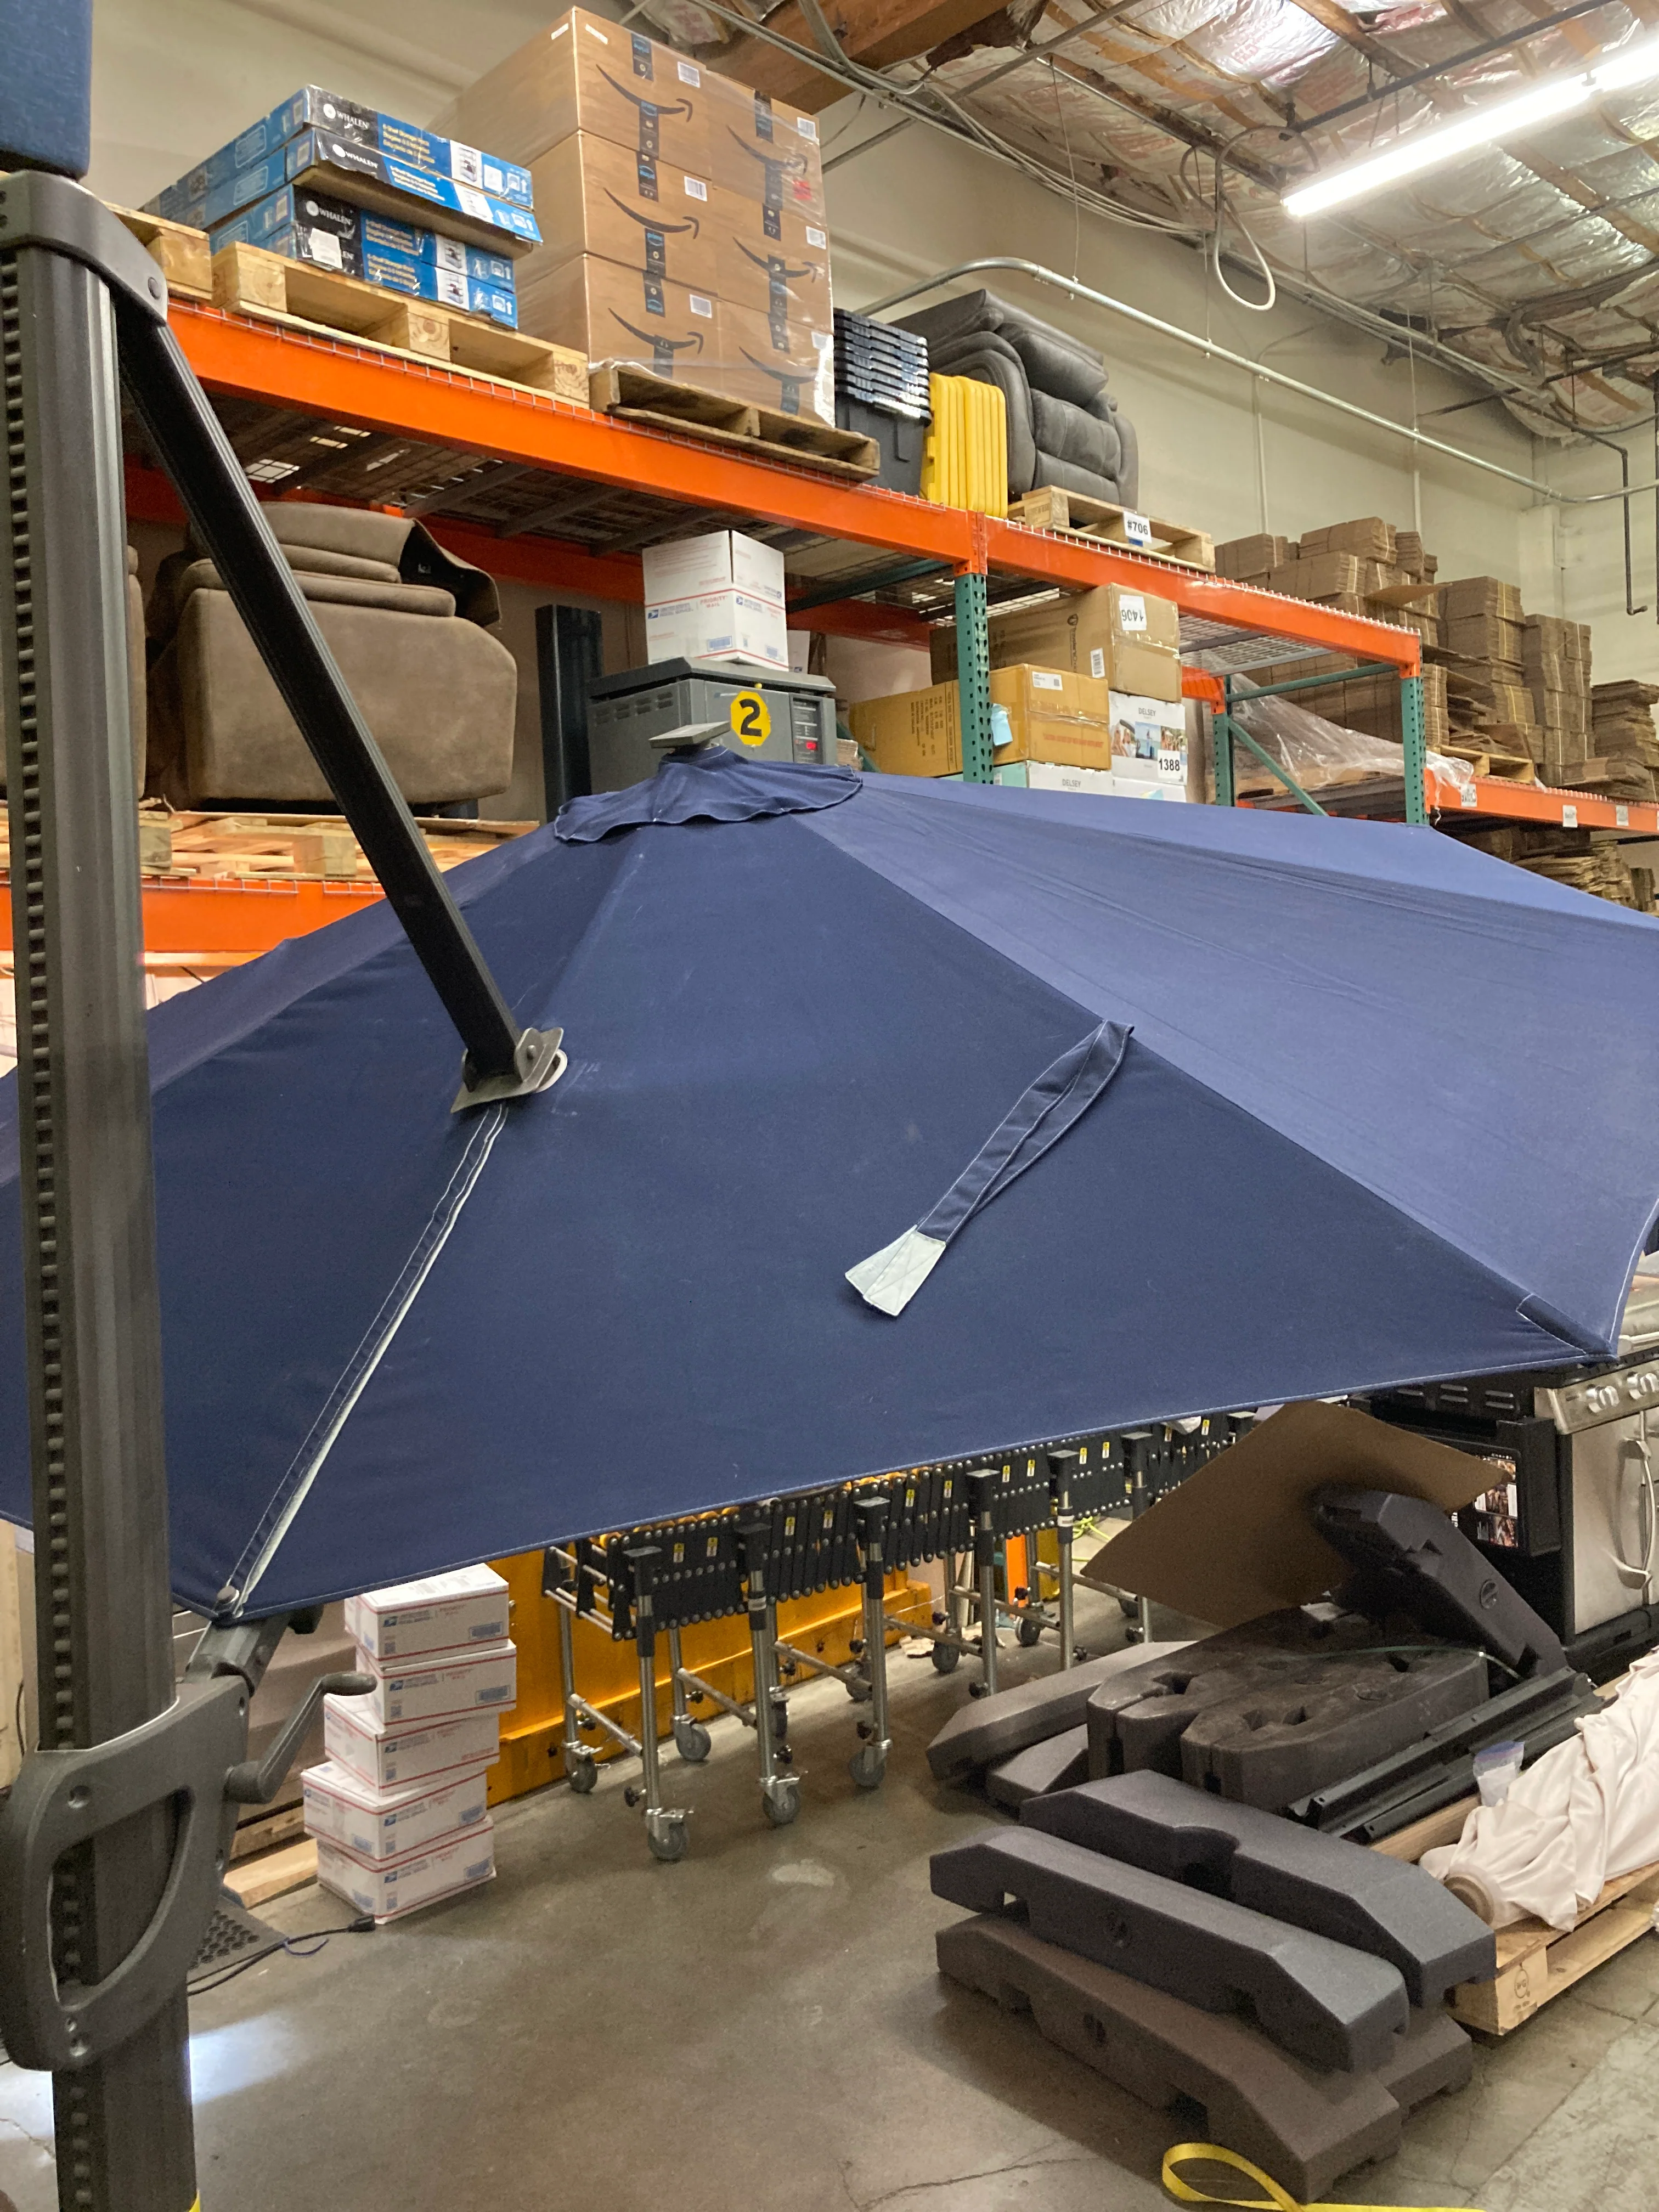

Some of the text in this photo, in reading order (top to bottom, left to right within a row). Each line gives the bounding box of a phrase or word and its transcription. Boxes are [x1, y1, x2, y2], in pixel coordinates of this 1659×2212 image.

[336, 110, 369, 130] WHALEN
[345, 150, 379, 168] WHALEN
[319, 207, 353, 225] WHALEN
[1127, 520, 1148, 535] #706
[699, 595, 726, 606] PRIORITY
[1121, 609, 1144, 622] 1406
[738, 698, 763, 737] 2
[1138, 707, 1156, 716] DELSEY
[1159, 758, 1180, 771] 1388
[1062, 778, 1081, 788] DELSEY
